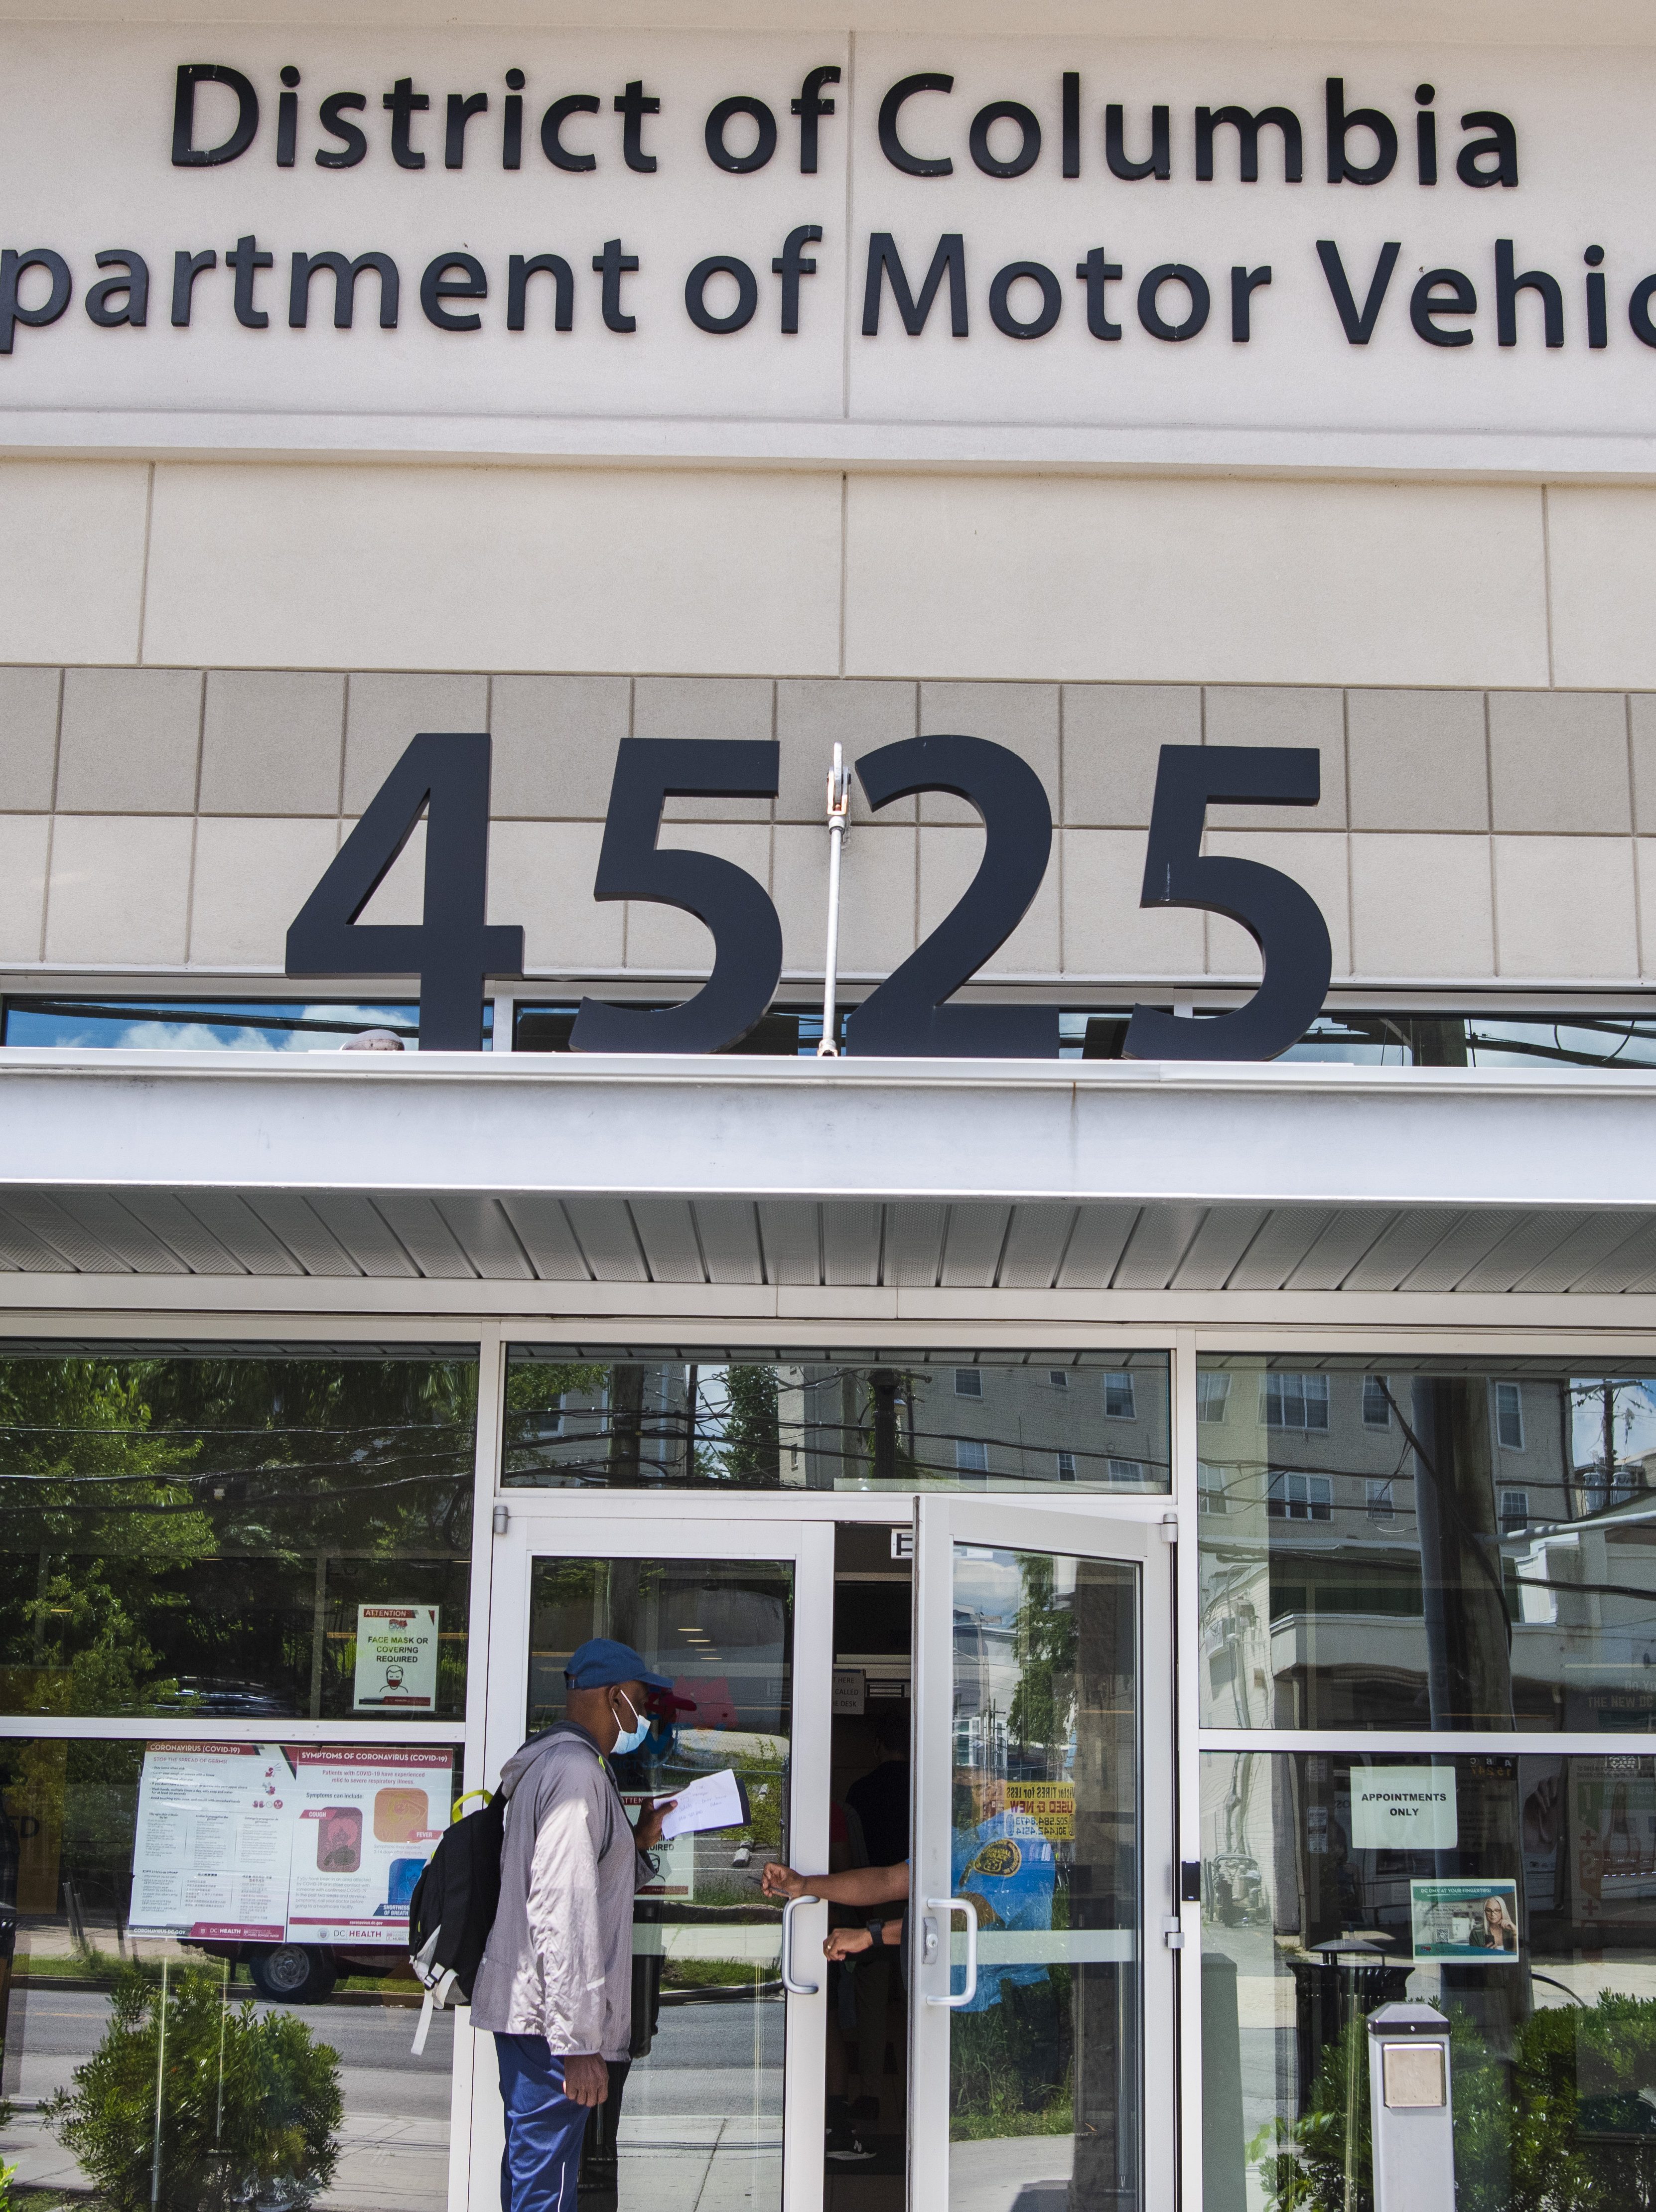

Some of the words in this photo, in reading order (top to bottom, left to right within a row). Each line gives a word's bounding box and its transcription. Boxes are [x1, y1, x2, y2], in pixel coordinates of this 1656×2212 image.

[172, 64, 660, 173] District
[704, 66, 841, 174] of
[878, 72, 1518, 188] Columbia
[684, 225, 824, 335] of
[861, 232, 1272, 343] Motor
[285, 731, 1332, 1061] 4525
[202, 1745, 240, 1754] (COVID-19)
